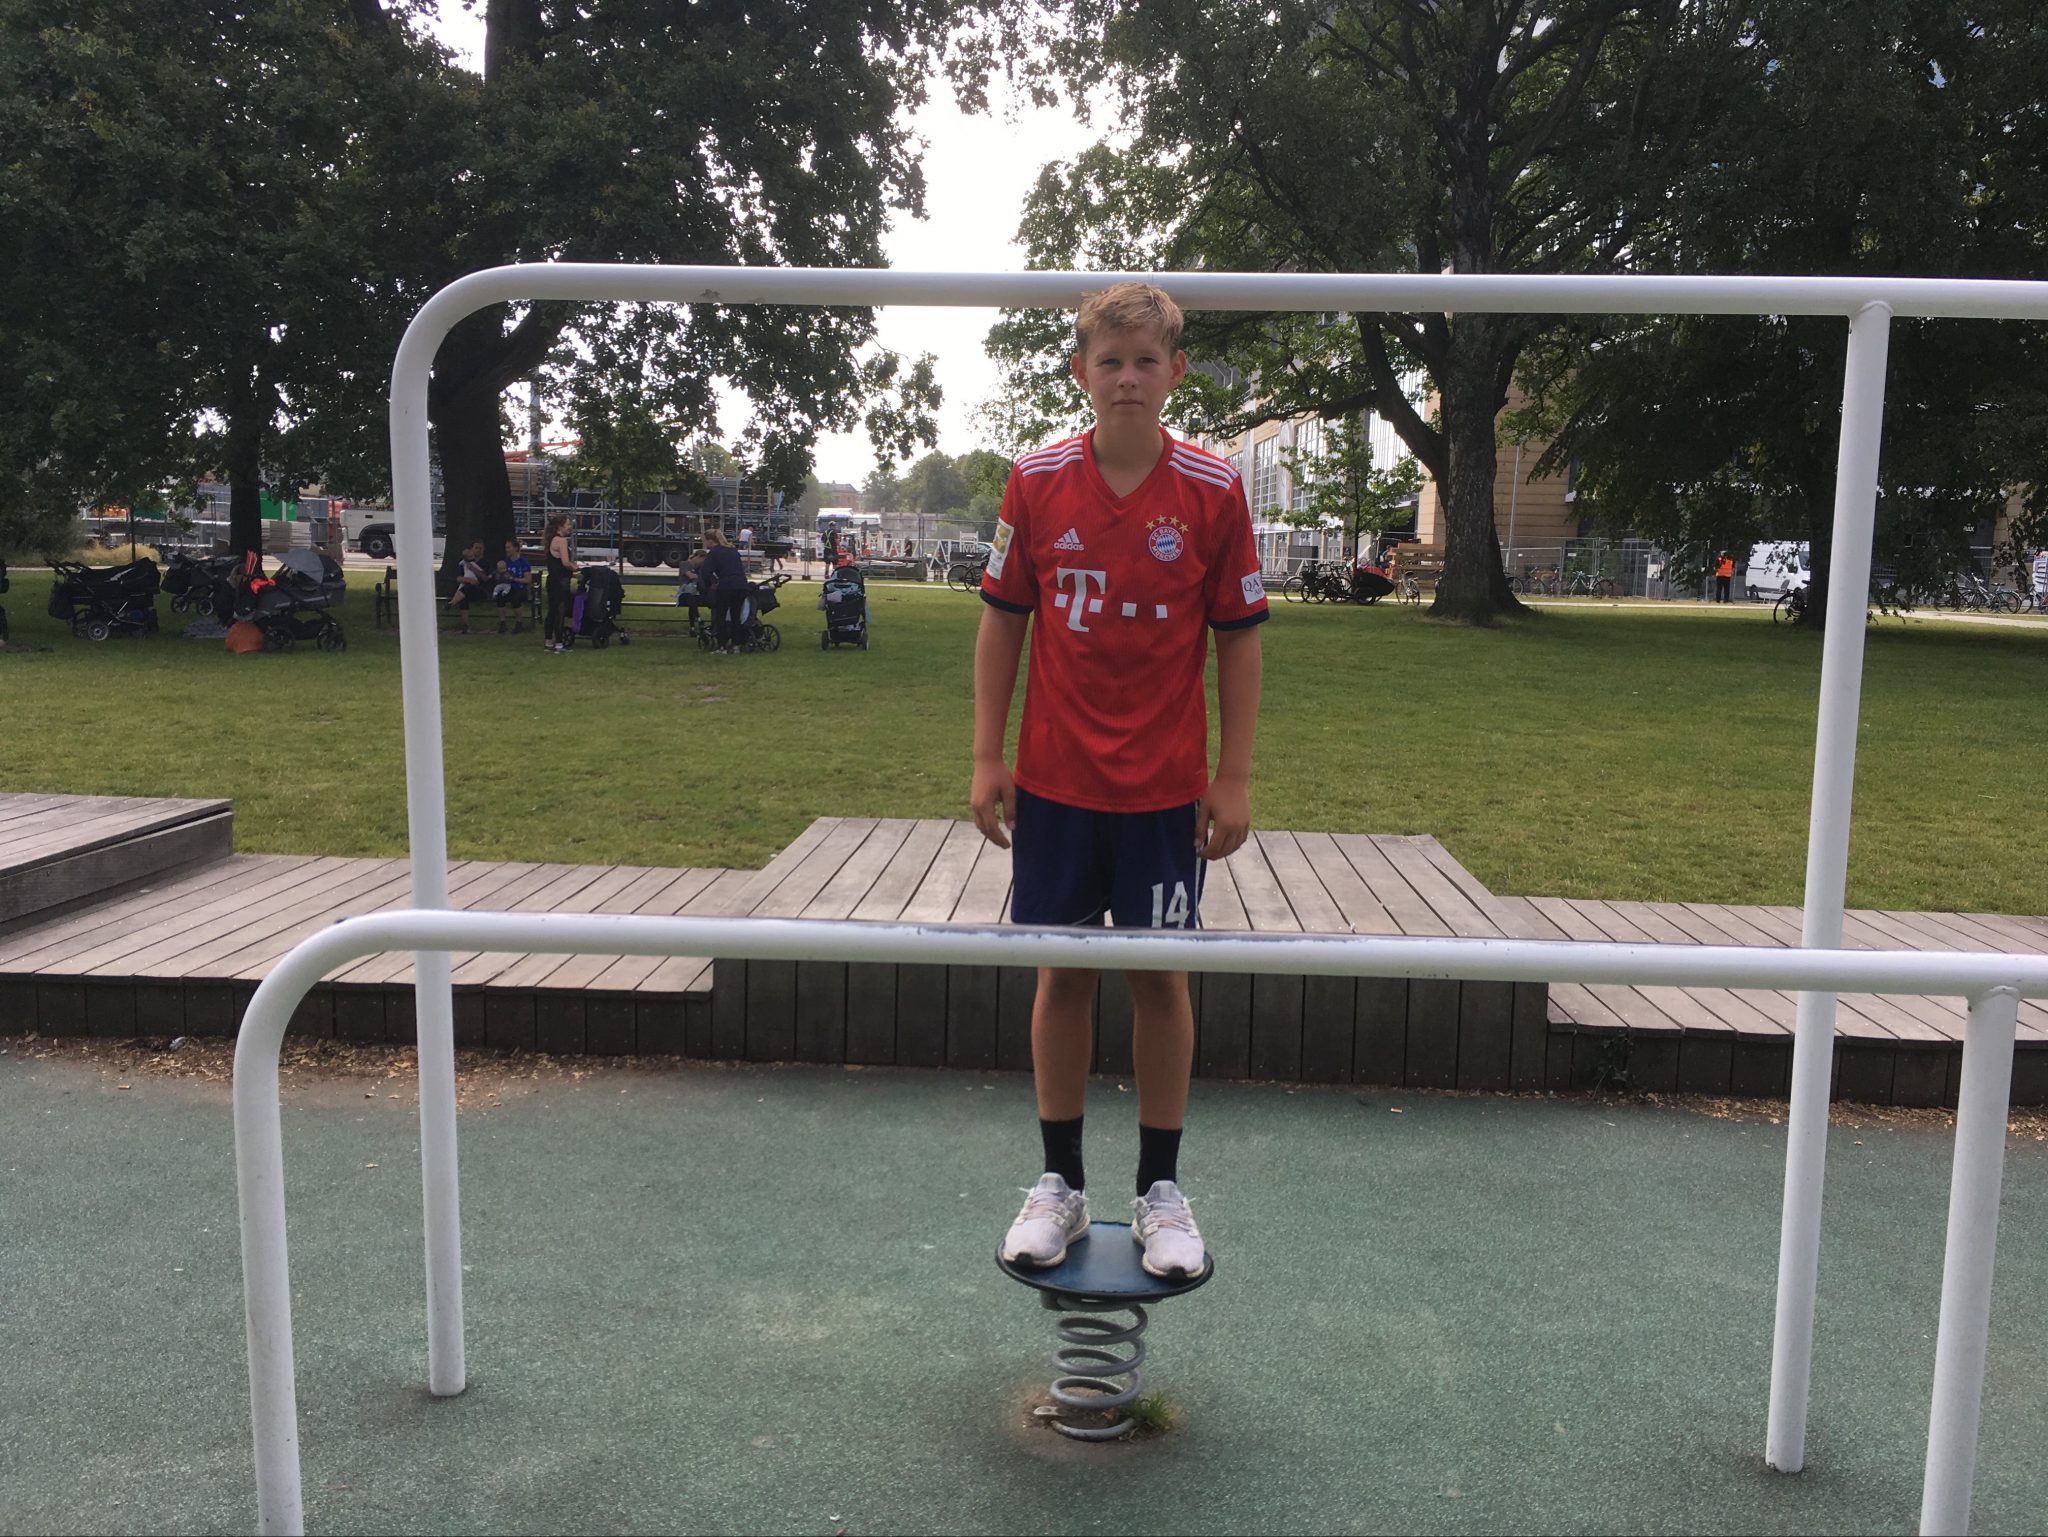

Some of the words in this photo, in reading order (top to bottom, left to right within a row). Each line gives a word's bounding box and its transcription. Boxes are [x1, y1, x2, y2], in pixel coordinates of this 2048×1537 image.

[1151, 531, 1160, 541] FC
[1159, 528, 1182, 543] BAYERN
[1053, 542, 1085, 551] adidas
[1151, 881, 1190, 929] 14
